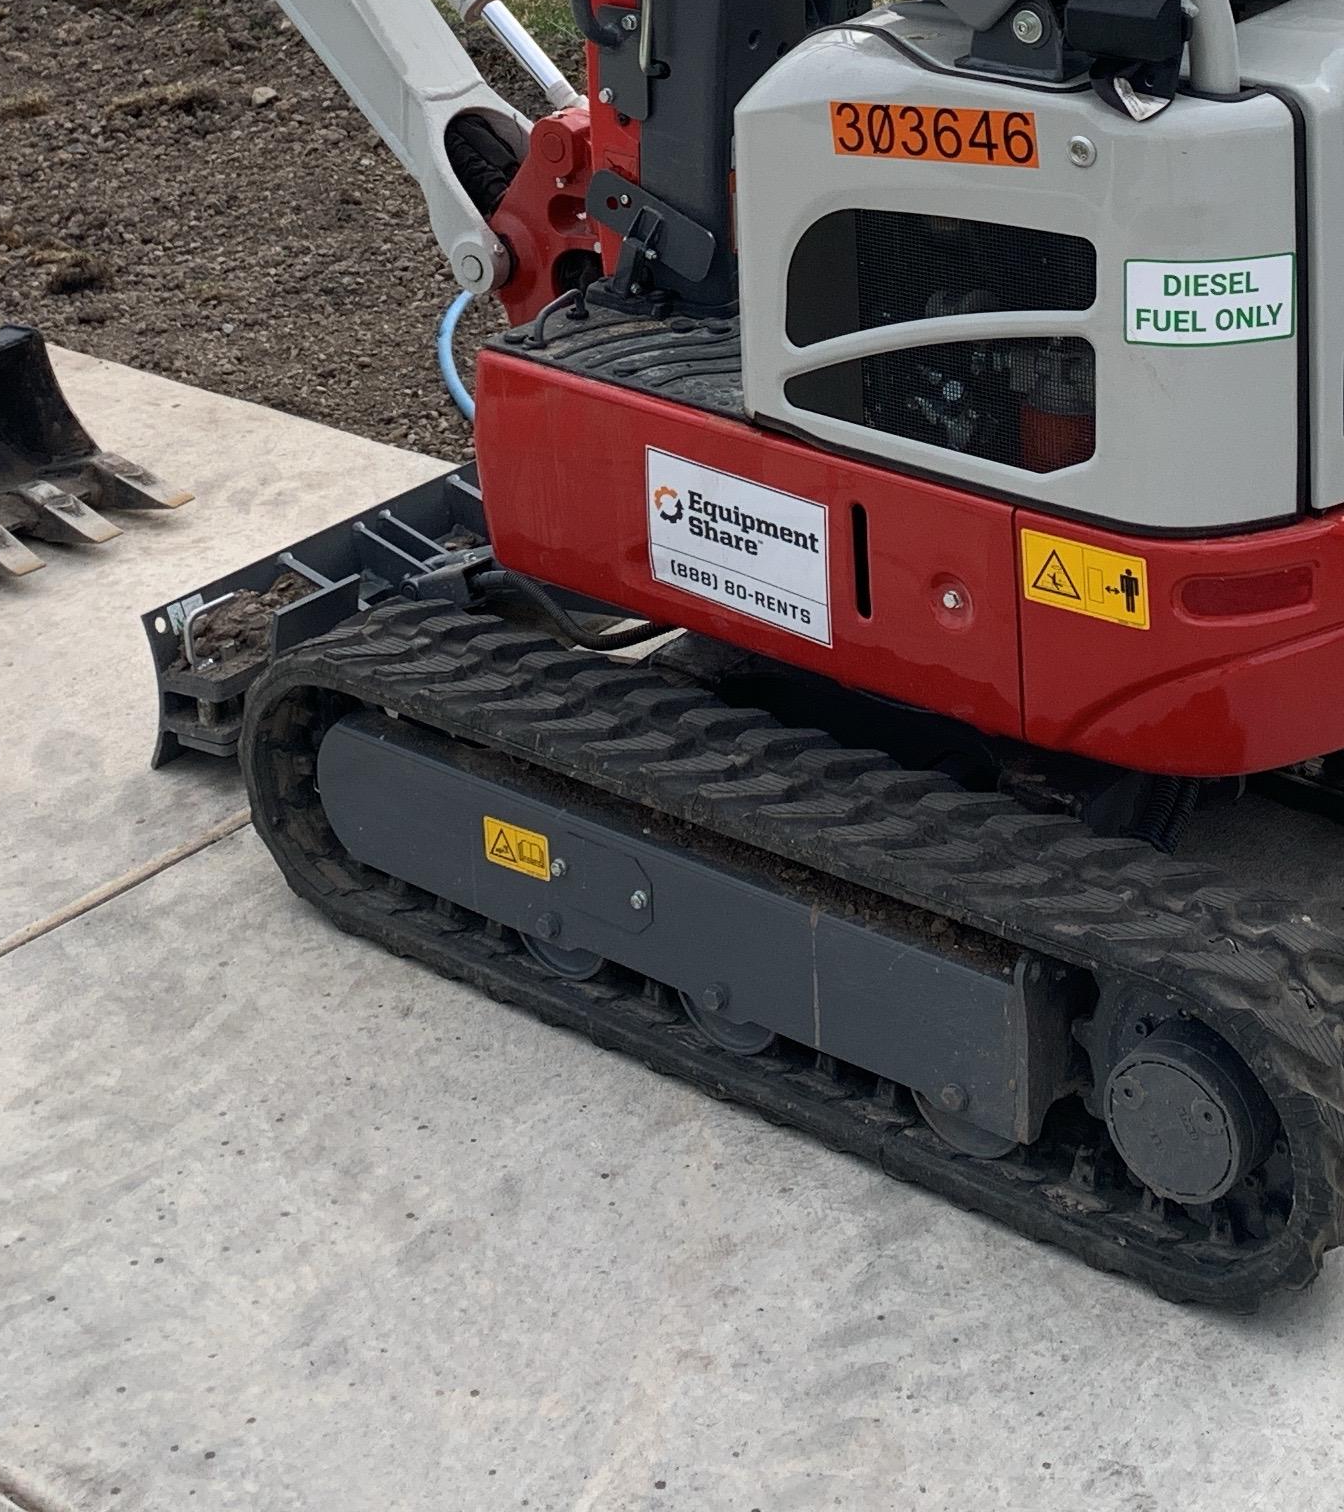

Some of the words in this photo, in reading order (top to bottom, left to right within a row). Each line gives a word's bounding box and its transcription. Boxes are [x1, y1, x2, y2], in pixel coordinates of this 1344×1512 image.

[836, 103, 1034, 164] 303646
[1163, 271, 1259, 297] DIESEL
[1136, 308, 1206, 333] FUEL
[1215, 303, 1284, 331] ONLY
[688, 489, 819, 554] Equipment
[688, 515, 759, 556] Share
[670, 559, 718, 590] (888)
[724, 579, 811, 625] 80-RENTS
